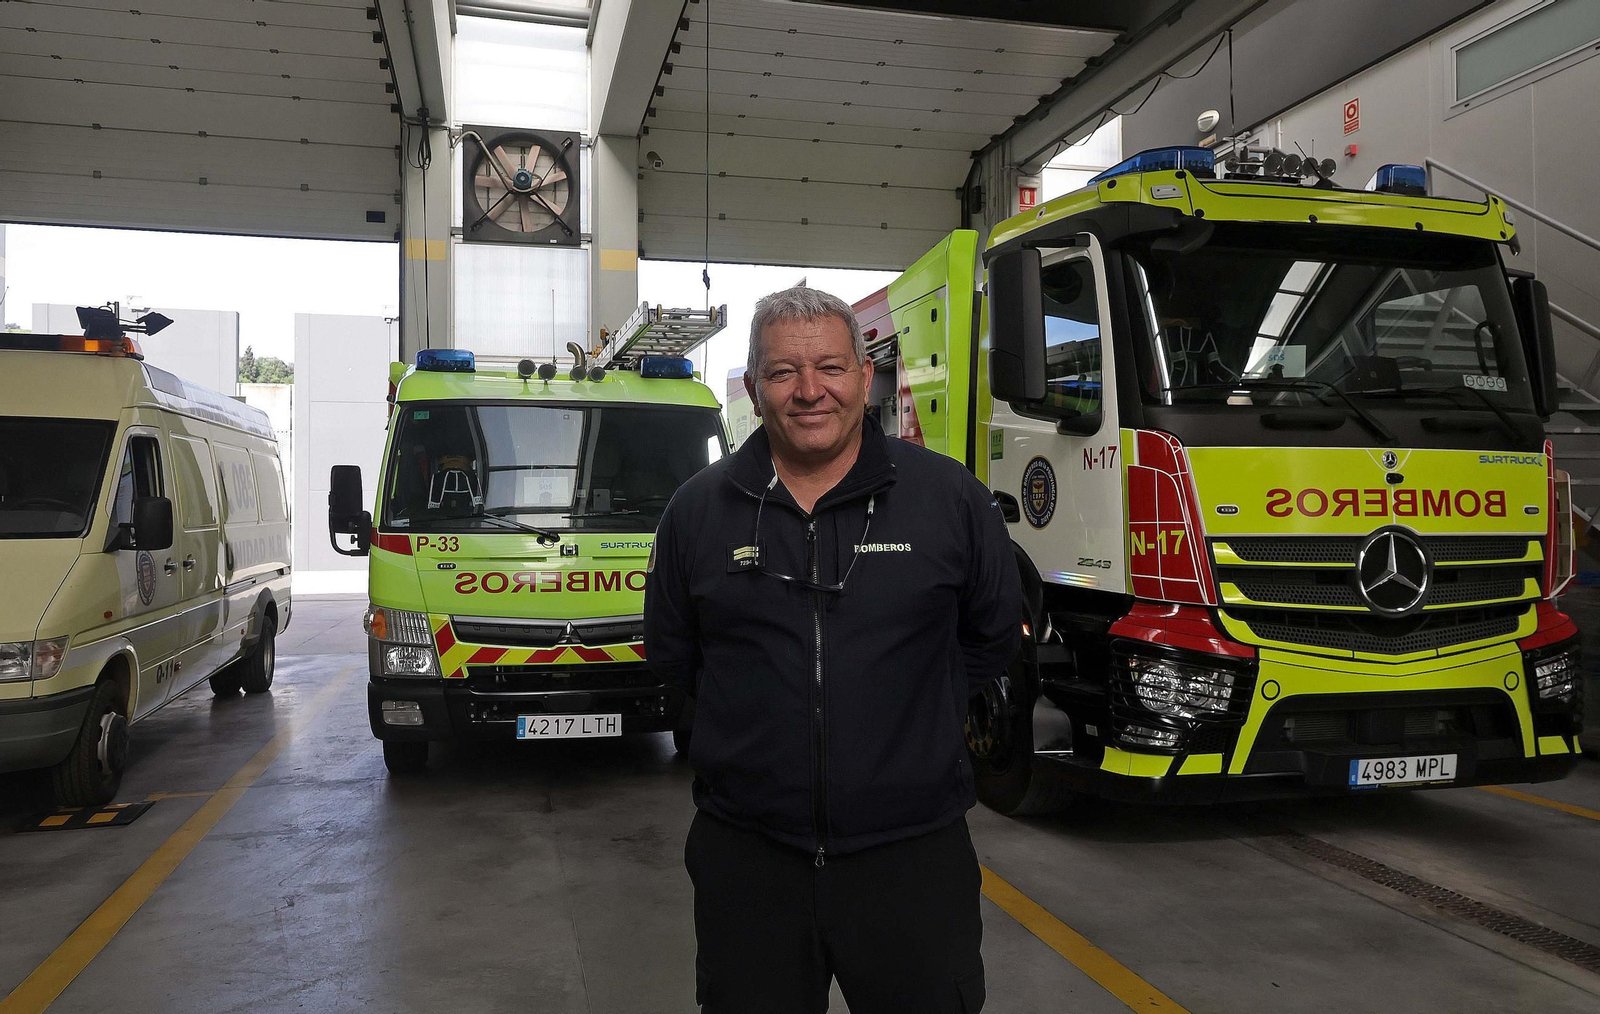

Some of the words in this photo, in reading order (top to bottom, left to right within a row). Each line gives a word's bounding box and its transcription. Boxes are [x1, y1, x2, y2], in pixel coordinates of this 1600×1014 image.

[1268, 354, 1285, 362] SOS
[1083, 446, 1117, 470] N-17
[1478, 455, 1538, 465] SURTRUCK
[231, 462, 255, 510] 085
[416, 535, 460, 552] P-33
[854, 543, 911, 553] BOMBEROS
[1130, 529, 1186, 556] N-17
[528, 718, 575, 735] 4217
[582, 717, 616, 734] LTH
[1361, 760, 1407, 781] 4983
[1416, 757, 1450, 778] MPL
